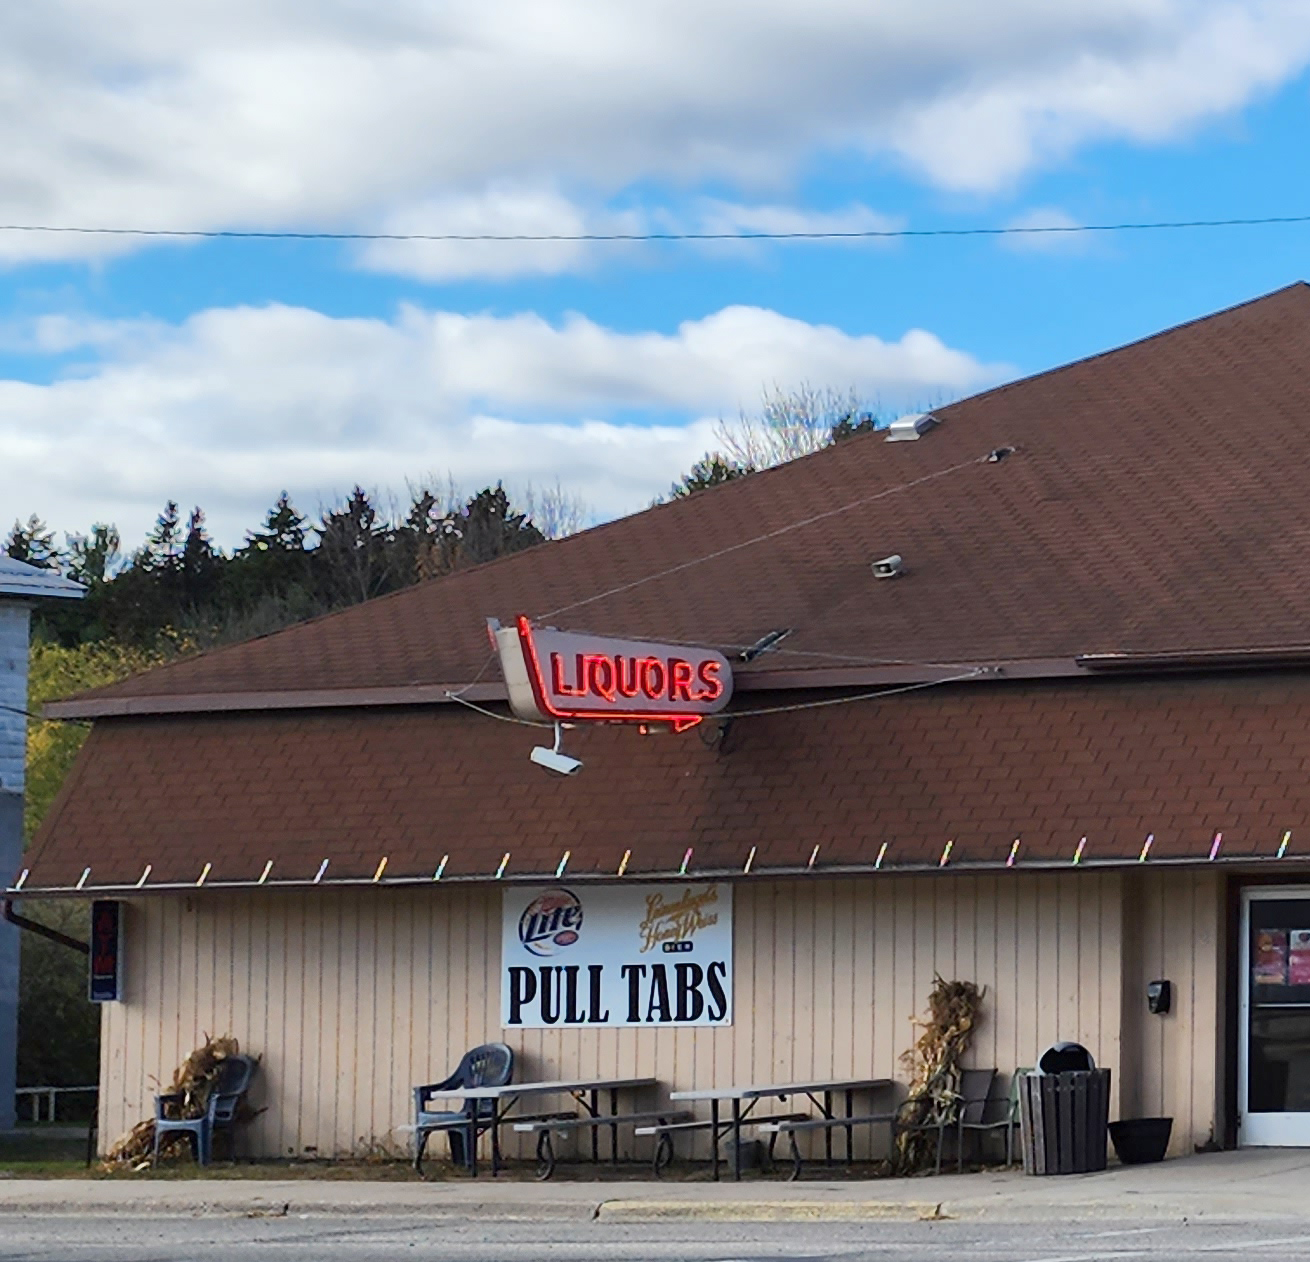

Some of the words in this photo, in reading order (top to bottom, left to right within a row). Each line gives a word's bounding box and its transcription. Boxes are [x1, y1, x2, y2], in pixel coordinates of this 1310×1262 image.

[551, 652, 724, 703] LIQUORS
[525, 905, 582, 943] Lite
[508, 965, 609, 1024] PULL
[621, 961, 727, 1023] TABS
